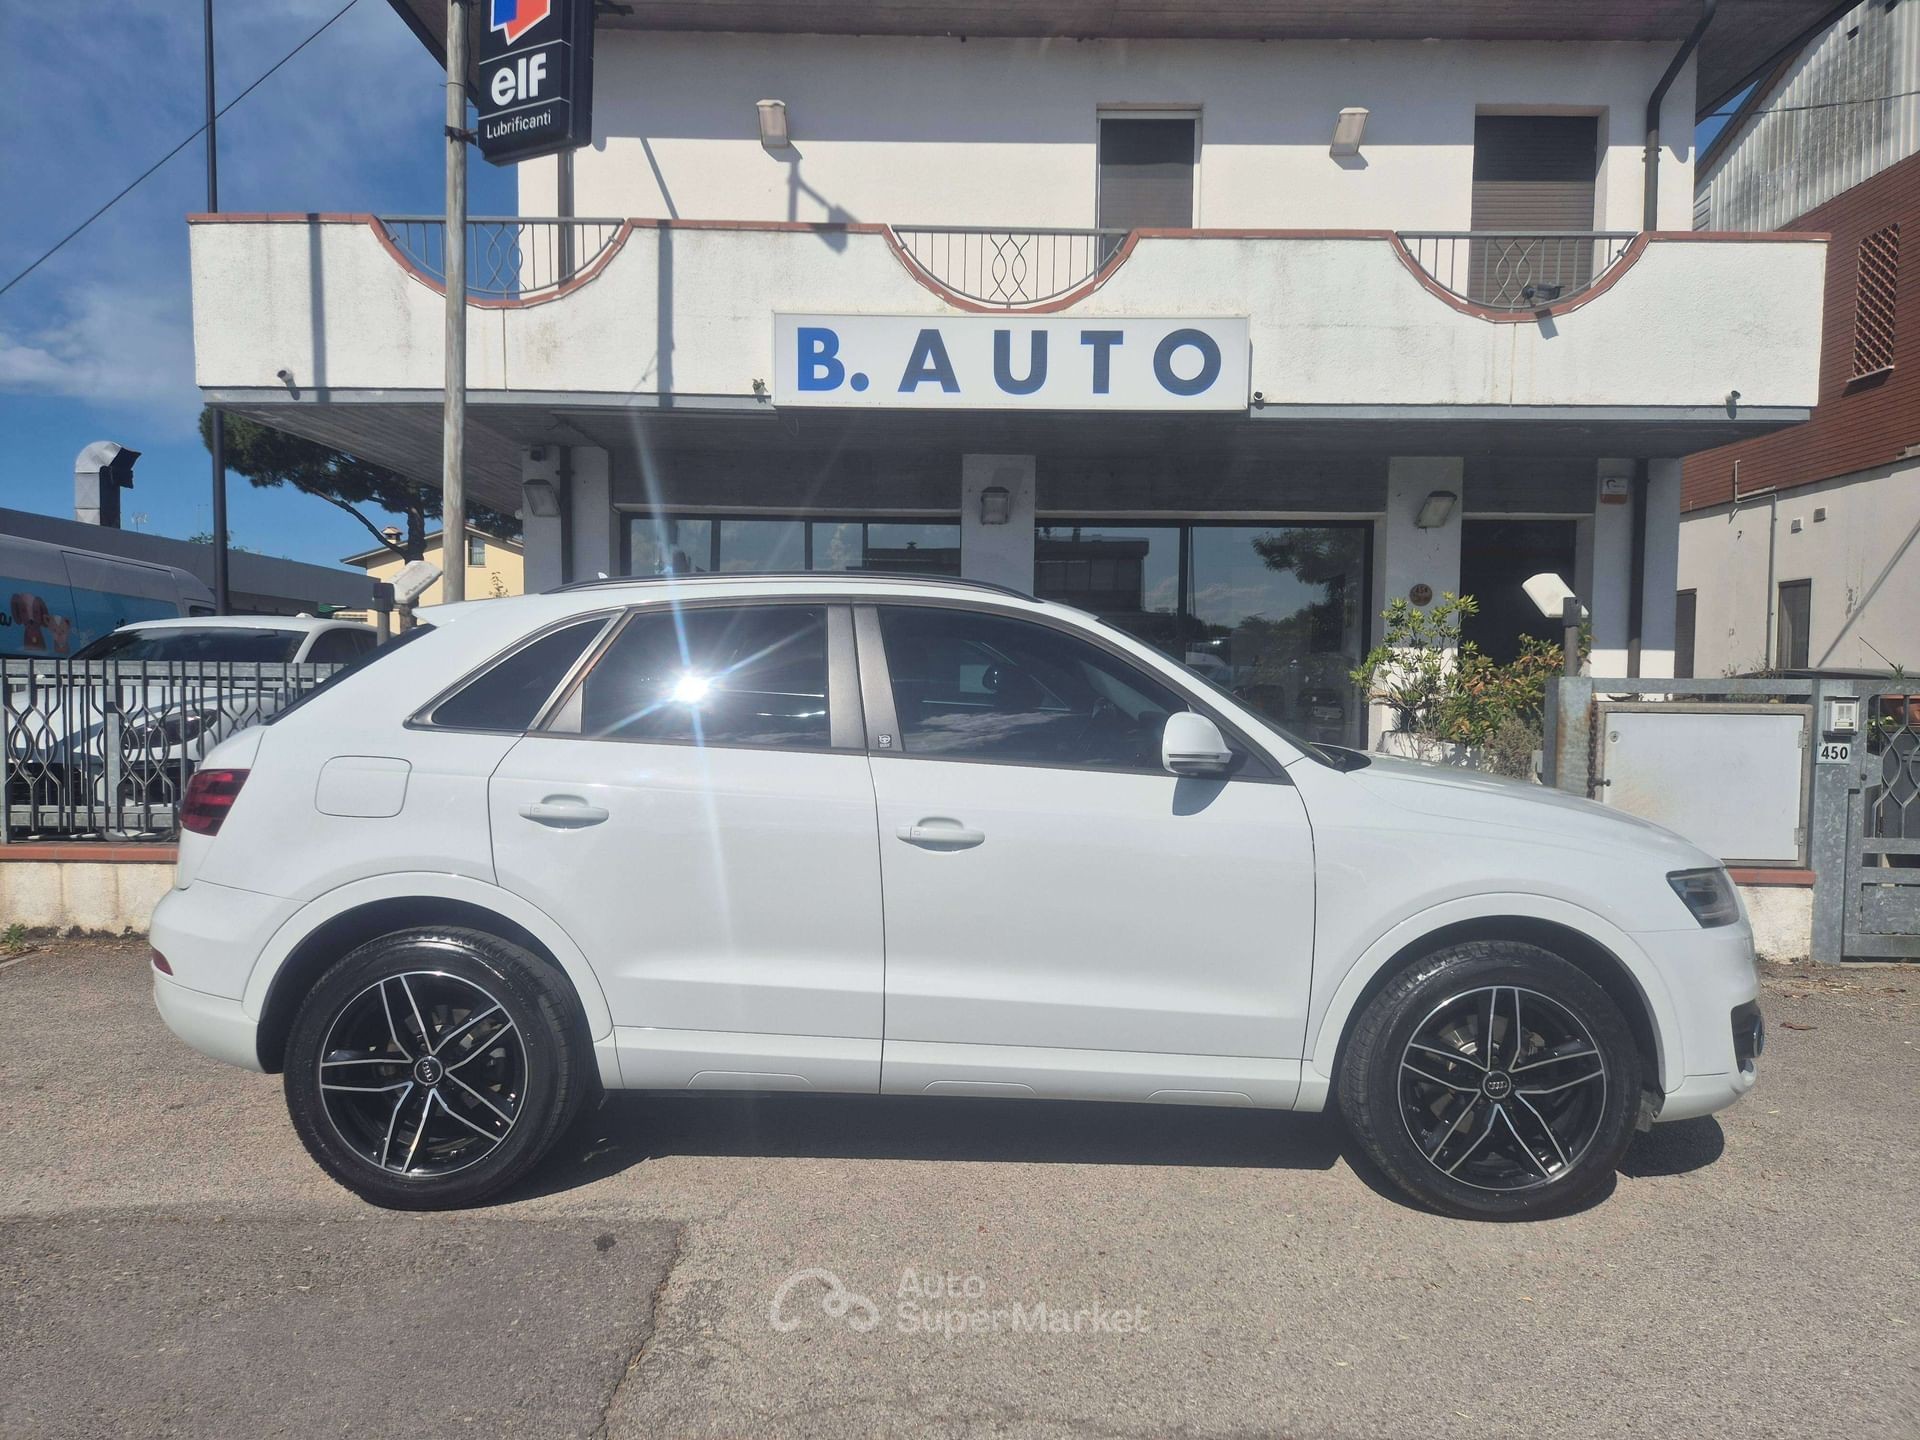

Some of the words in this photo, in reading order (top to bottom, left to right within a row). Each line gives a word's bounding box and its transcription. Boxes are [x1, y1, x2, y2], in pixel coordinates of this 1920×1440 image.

[491, 52, 547, 106] elf
[486, 110, 551, 139] Lubrificanti
[797, 327, 870, 392] B.
[897, 328, 1222, 396] AUTO
[1821, 746, 1848, 759] 450
